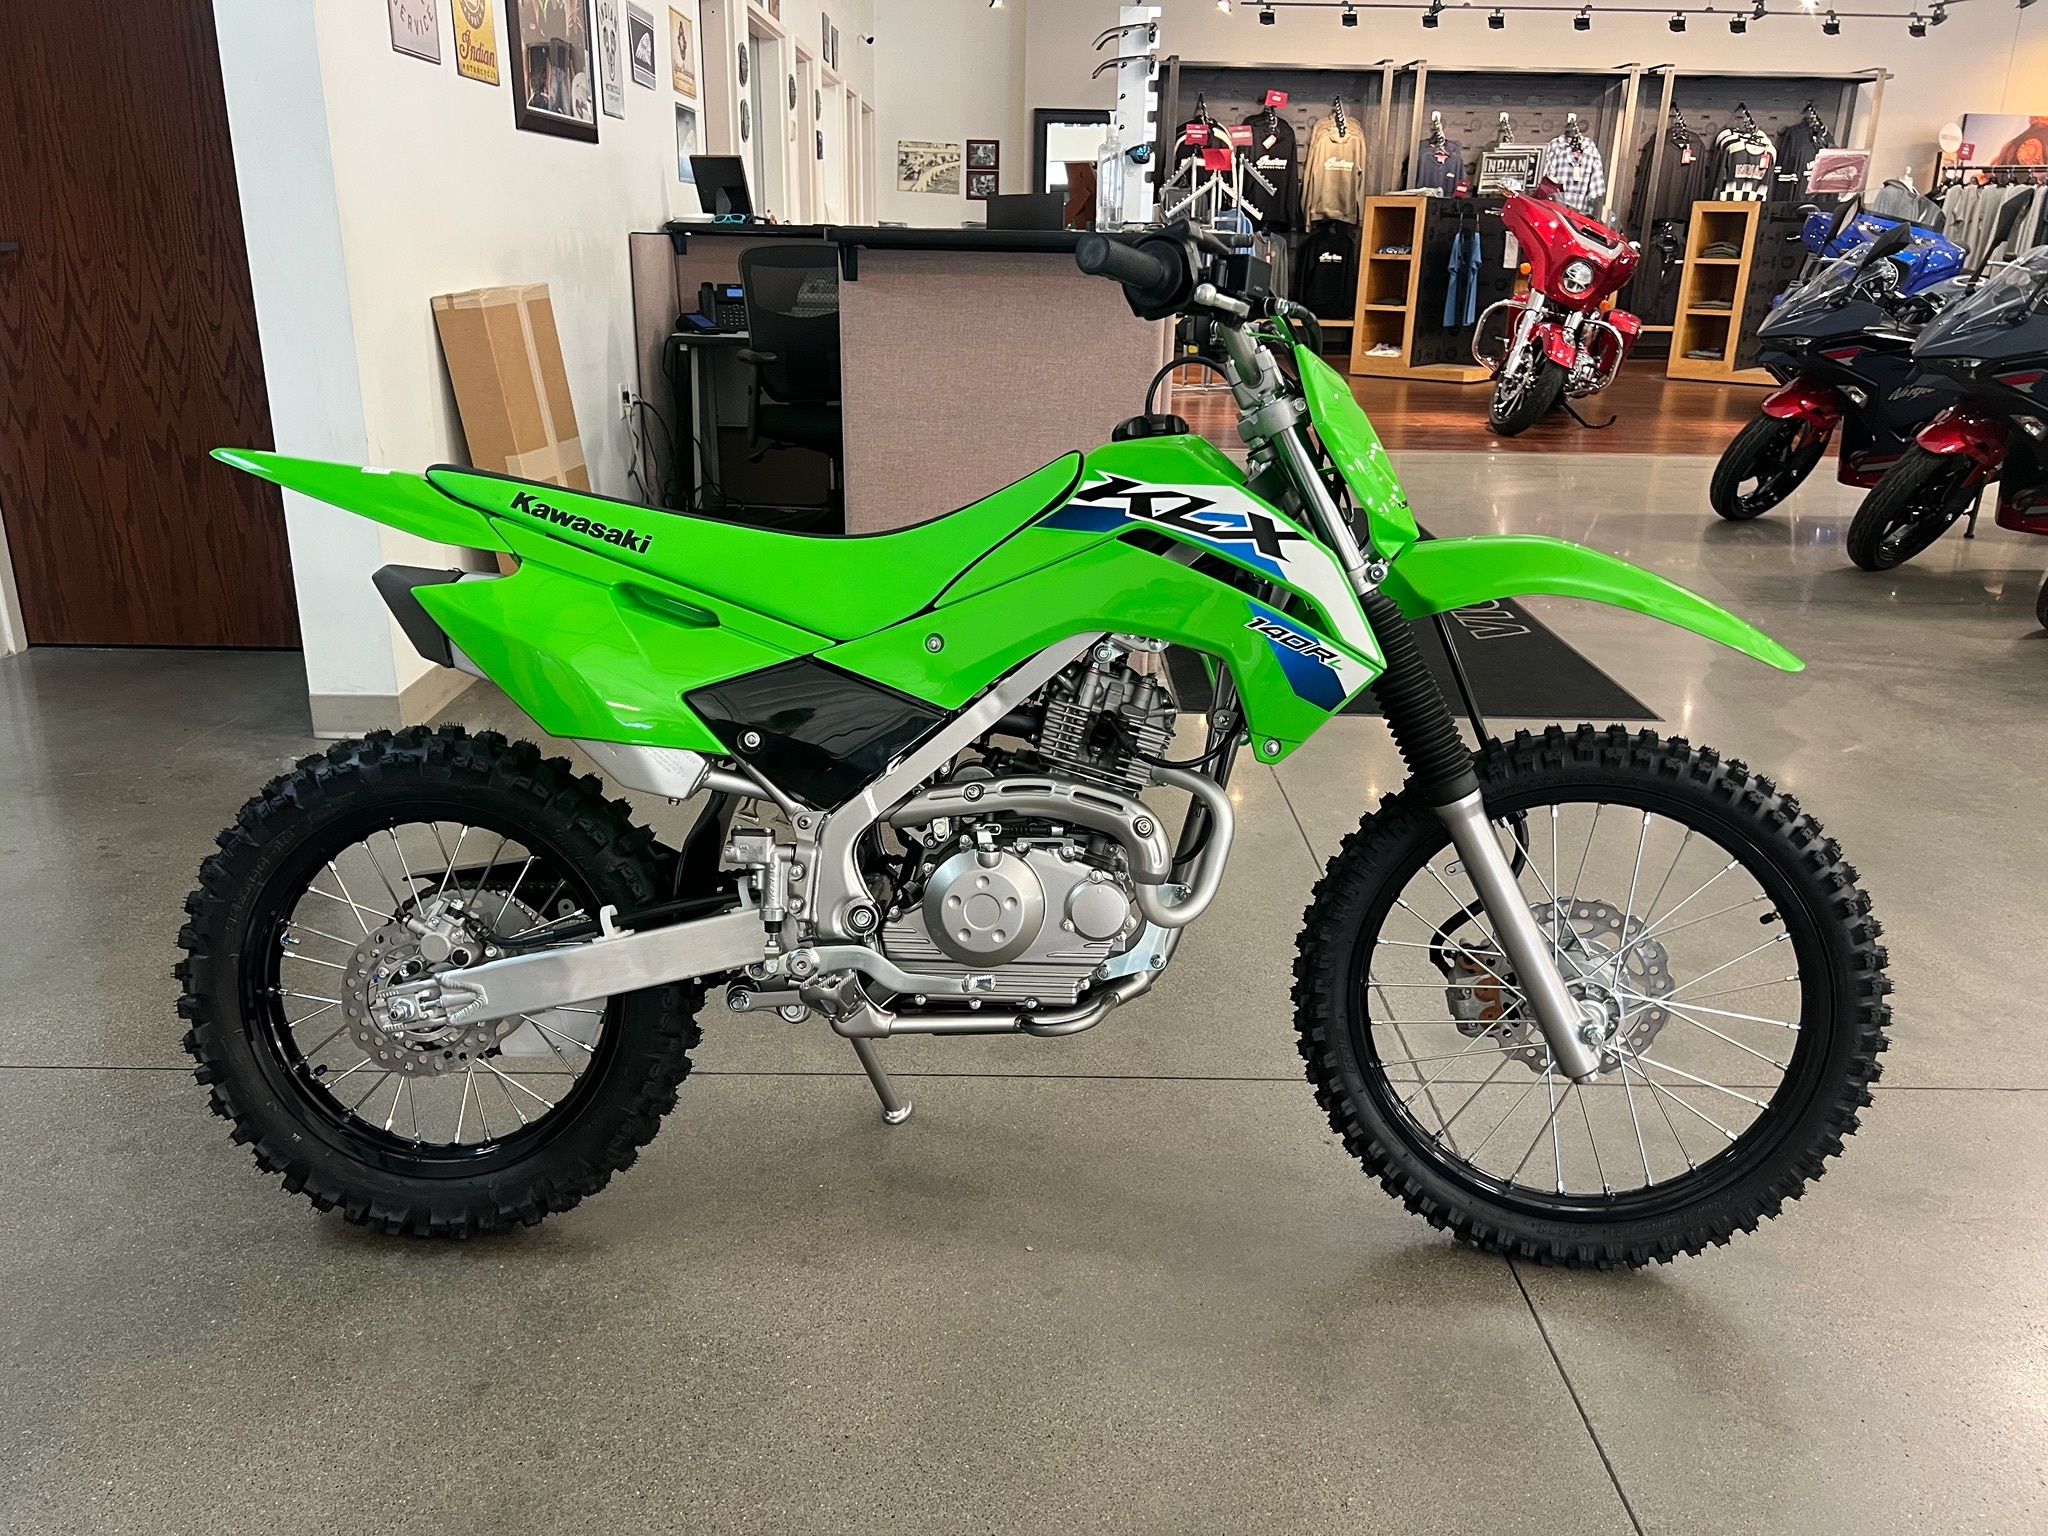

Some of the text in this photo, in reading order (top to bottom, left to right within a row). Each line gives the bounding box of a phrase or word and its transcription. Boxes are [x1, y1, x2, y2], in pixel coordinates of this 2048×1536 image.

[460, 29, 495, 68] Indian
[462, 63, 497, 79] MOTORCYCLE
[1484, 158, 1527, 173] INDIAN
[1888, 384, 1936, 401] Ninja
[509, 491, 653, 554] Kawasaki
[1073, 473, 1309, 565] KLX
